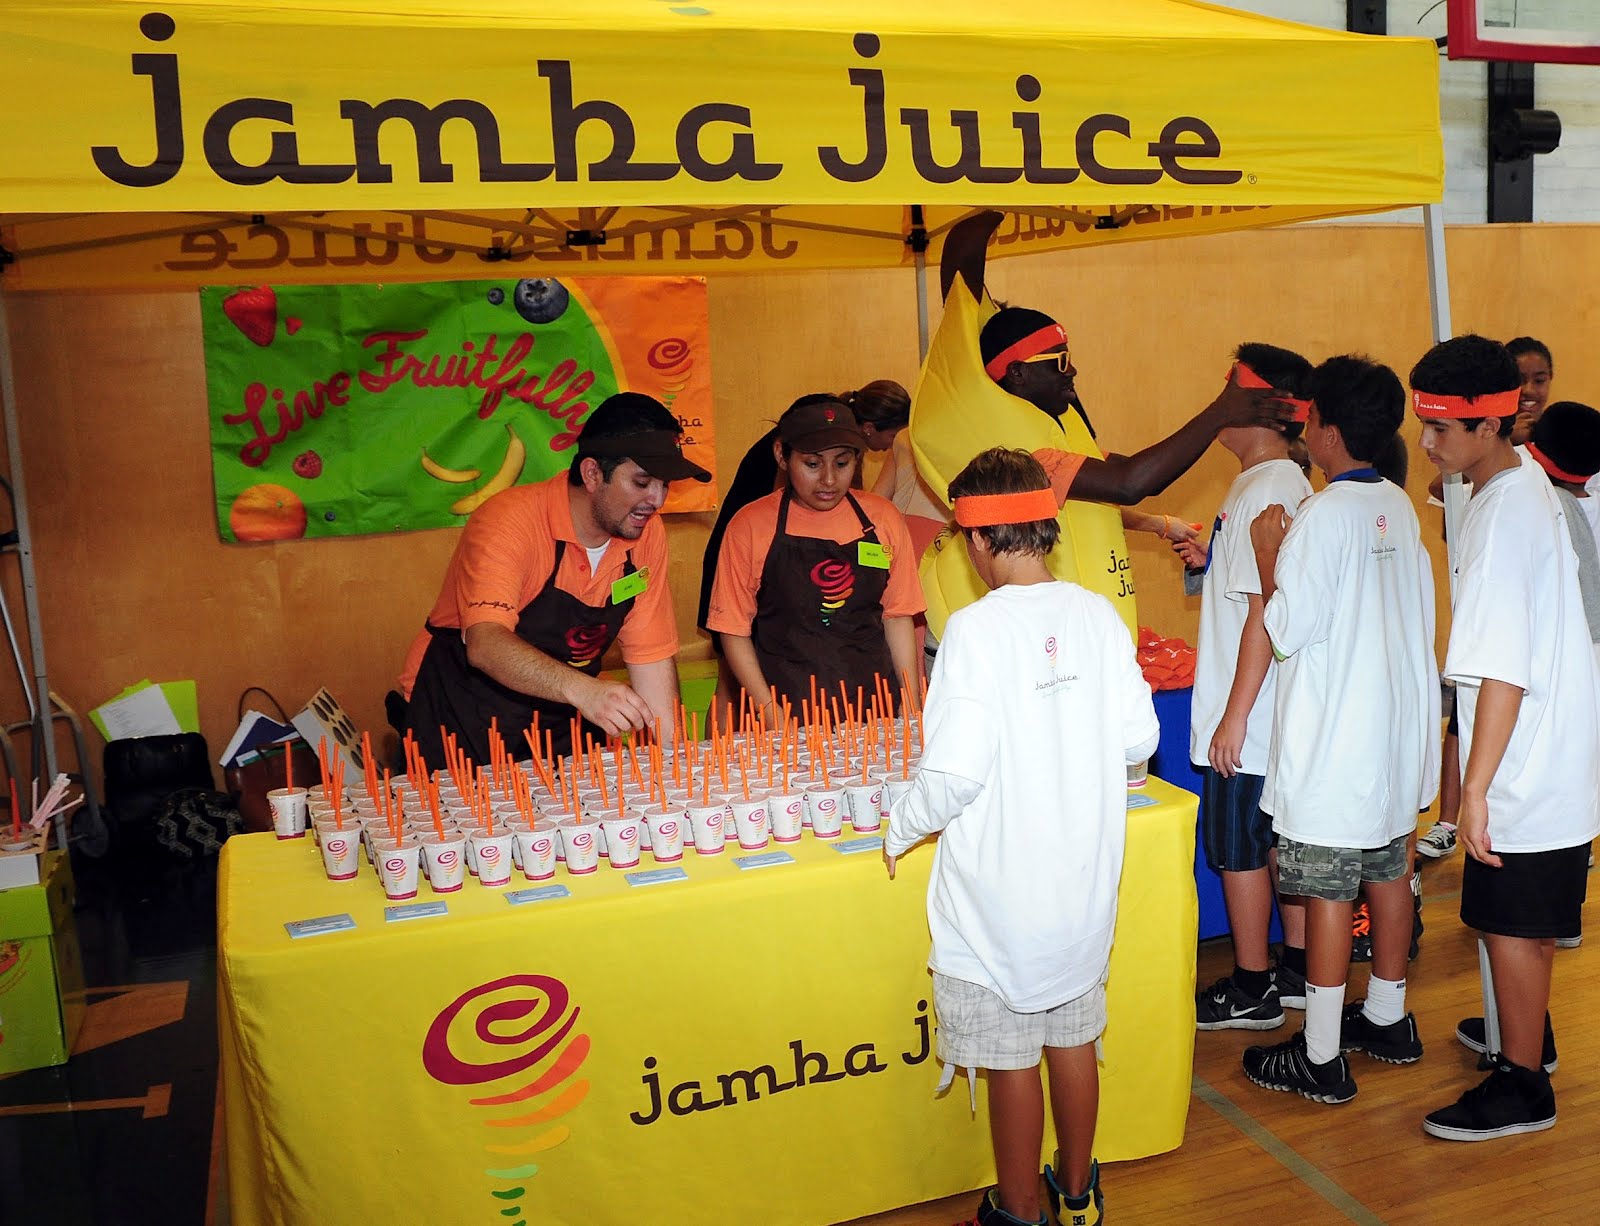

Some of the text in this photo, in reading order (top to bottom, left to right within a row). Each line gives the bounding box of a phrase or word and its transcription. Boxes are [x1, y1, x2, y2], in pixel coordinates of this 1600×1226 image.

[91, 12, 1243, 187] jamba juice
[224, 328, 595, 467] Live Fruitfully
[630, 1040, 886, 1125] jamba
